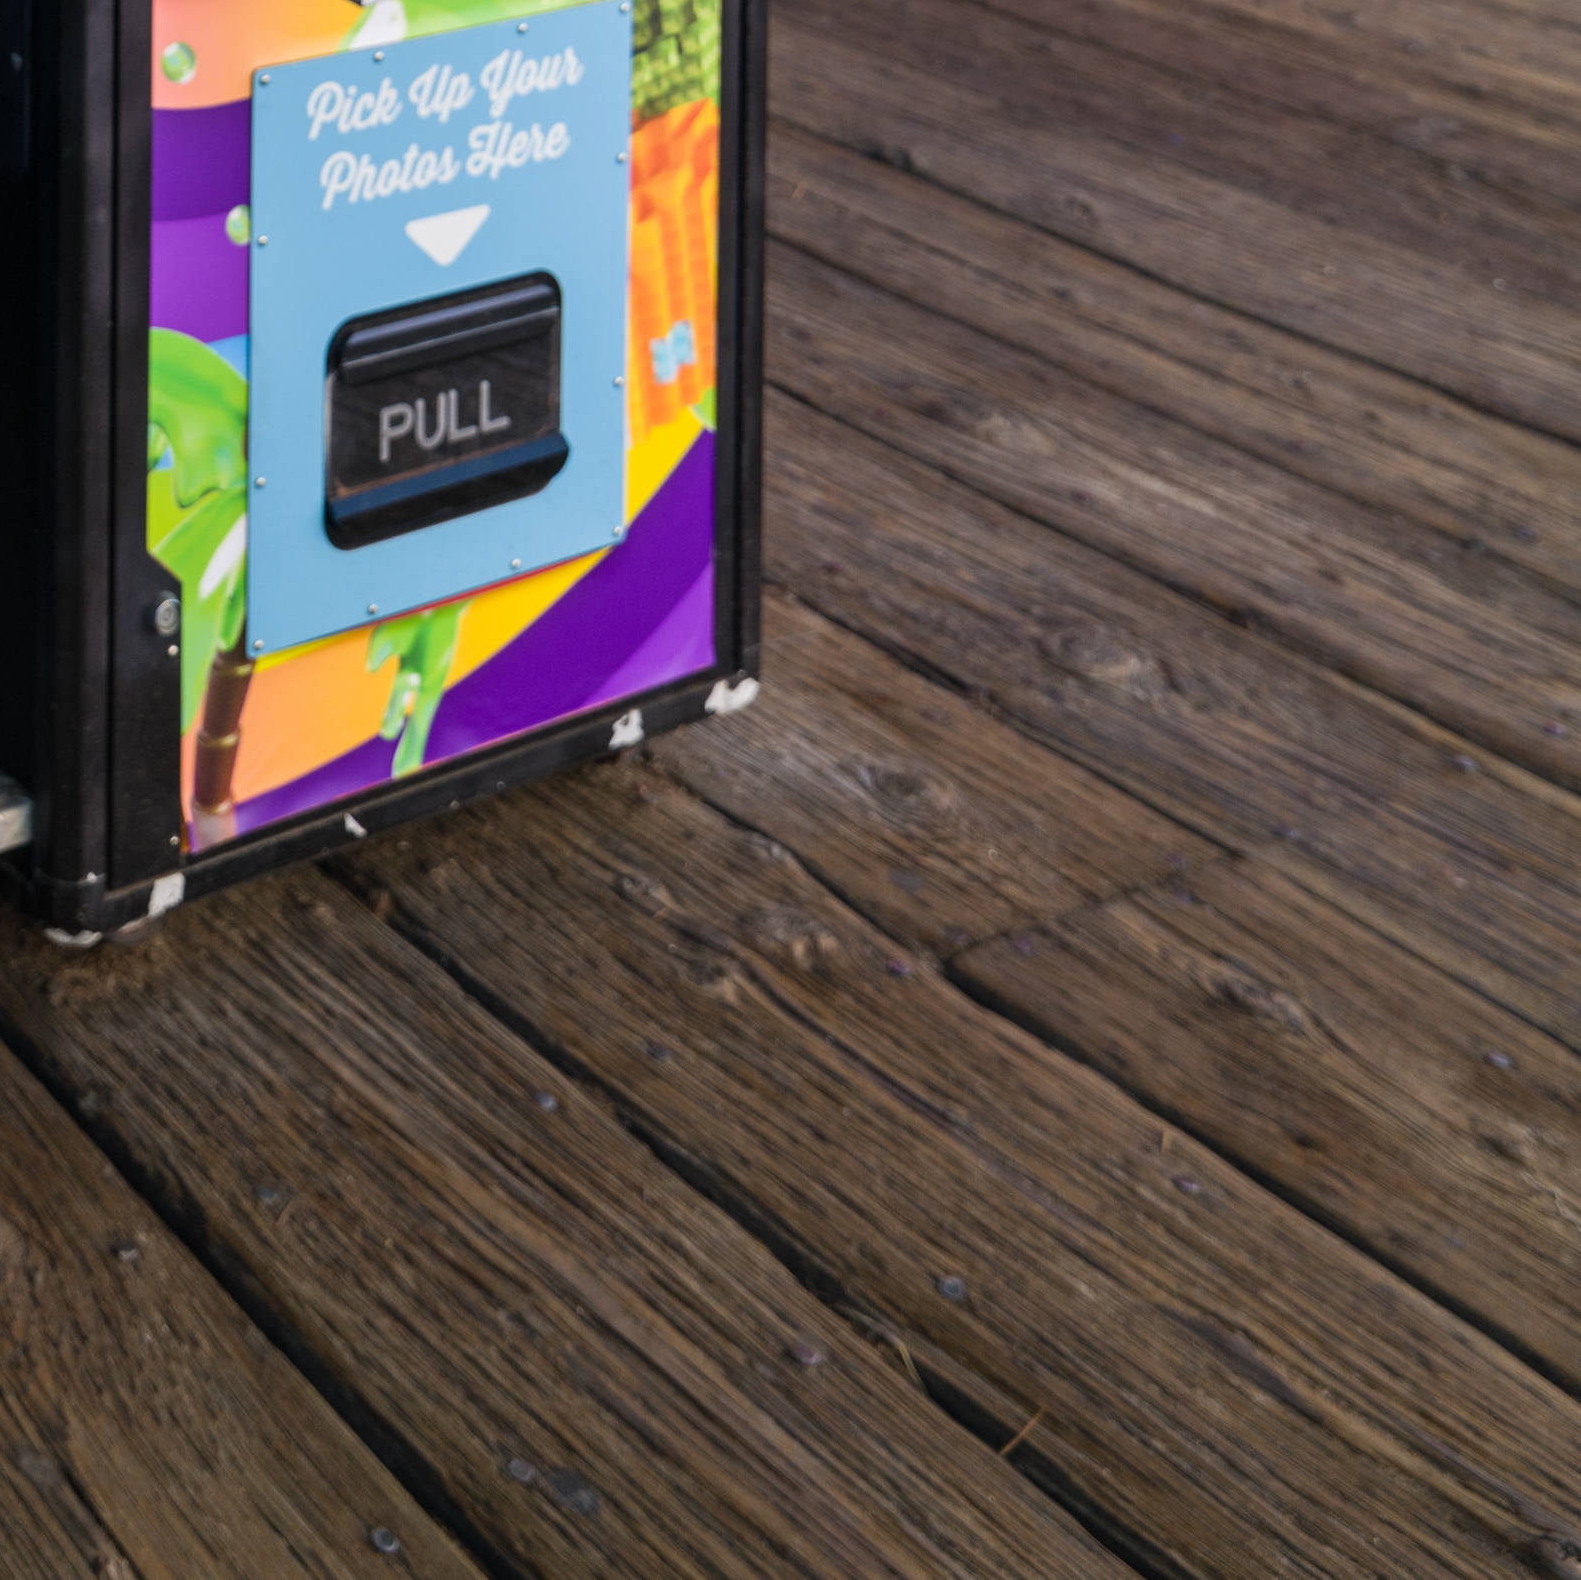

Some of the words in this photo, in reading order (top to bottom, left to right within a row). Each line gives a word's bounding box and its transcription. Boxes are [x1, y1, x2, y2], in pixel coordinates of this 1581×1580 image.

[305, 75, 402, 141] Pick
[407, 62, 476, 126] Up
[480, 45, 584, 118] Your
[319, 142, 462, 210] Photos
[465, 119, 572, 180] Here
[379, 380, 512, 462] PULL
